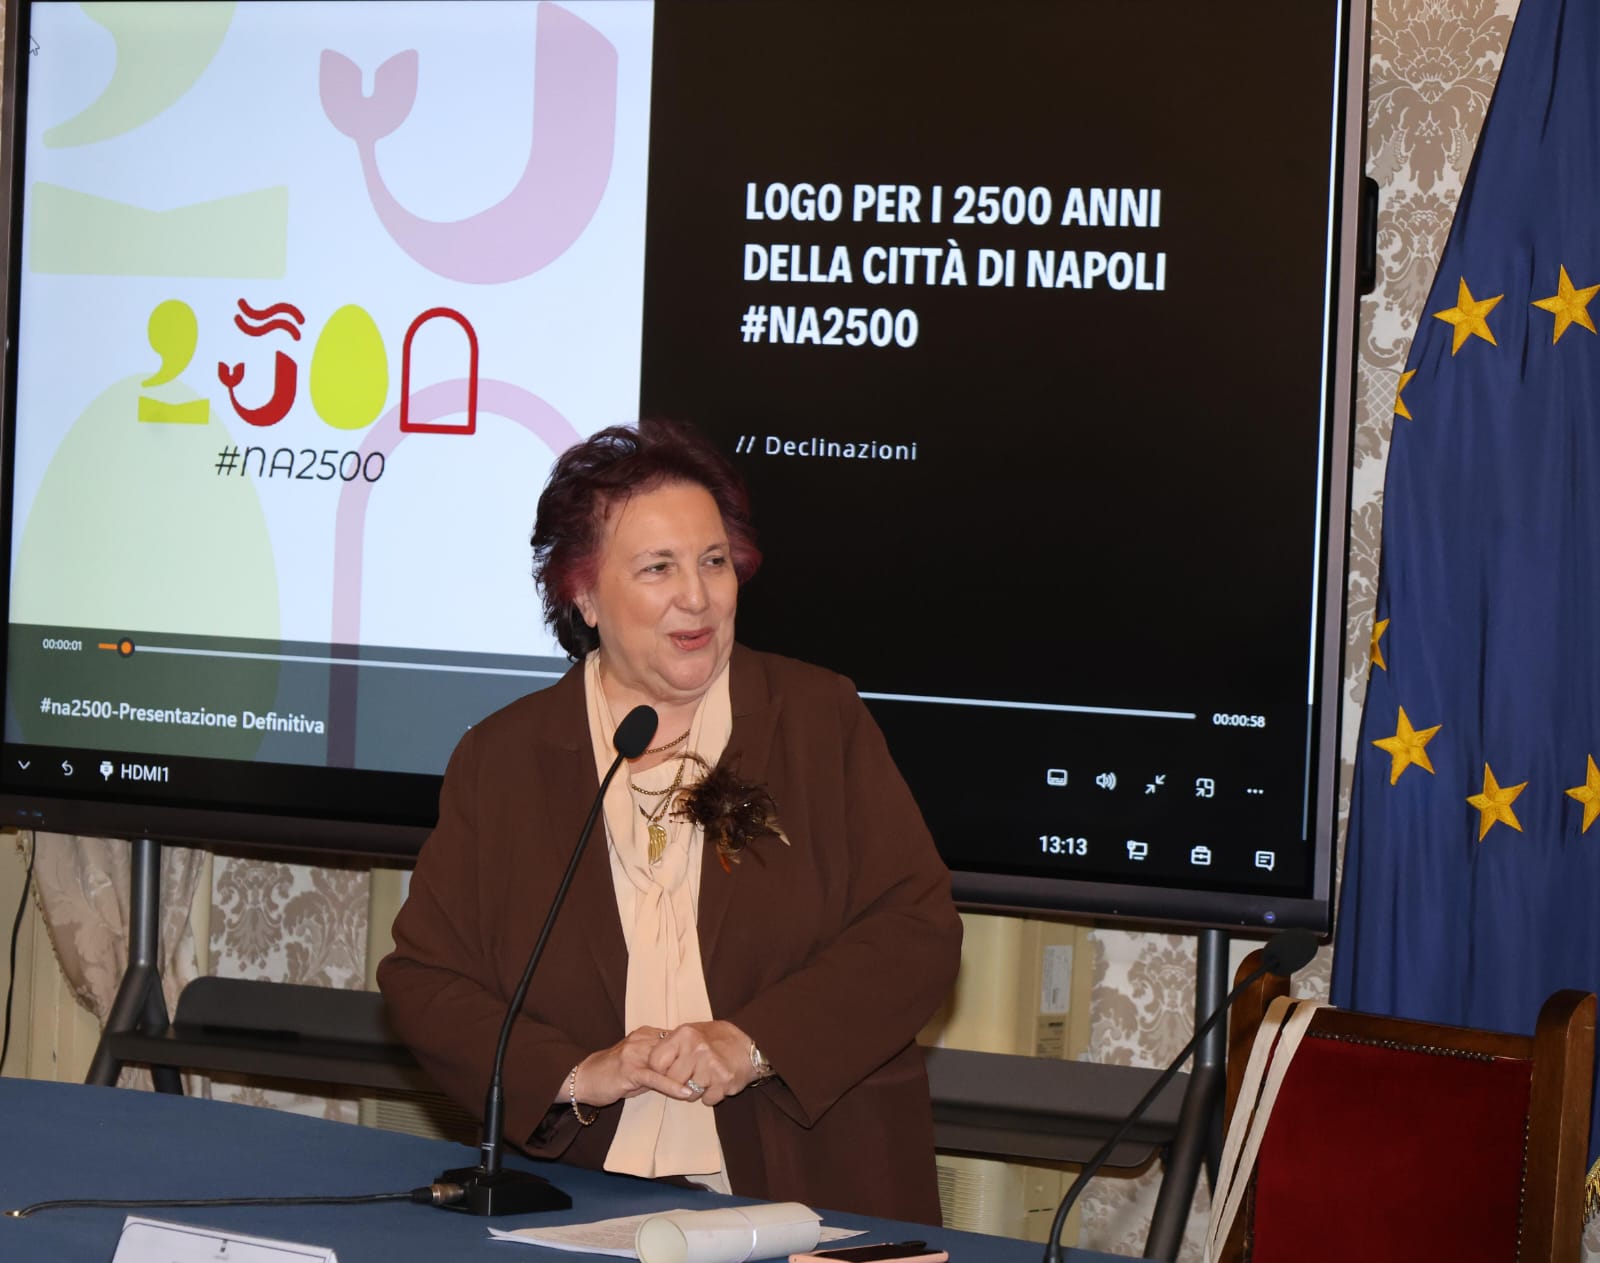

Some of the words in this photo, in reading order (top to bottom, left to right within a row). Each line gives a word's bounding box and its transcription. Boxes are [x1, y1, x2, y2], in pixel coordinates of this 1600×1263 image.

[746, 182, 842, 222] LOGO
[852, 184, 921, 223] PER
[931, 185, 943, 224] I
[953, 185, 1052, 226] 2500
[1061, 187, 1161, 228] ANNI
[743, 243, 852, 284] DELLA
[862, 238, 967, 286] CITTÀ
[977, 248, 1015, 288] DI
[1026, 250, 1166, 291] NAPOLI
[740, 305, 919, 348] #NA2500
[765, 436, 917, 460] Declinazioni
[42, 638, 83, 651] 00:00:01
[40, 697, 237, 729] #na2500-Presentazione
[242, 710, 325, 735] Definitiva
[1212, 712, 1266, 728] 00:00:58
[120, 763, 170, 783] HDMI1
[1039, 835, 1088, 856] 13:13
